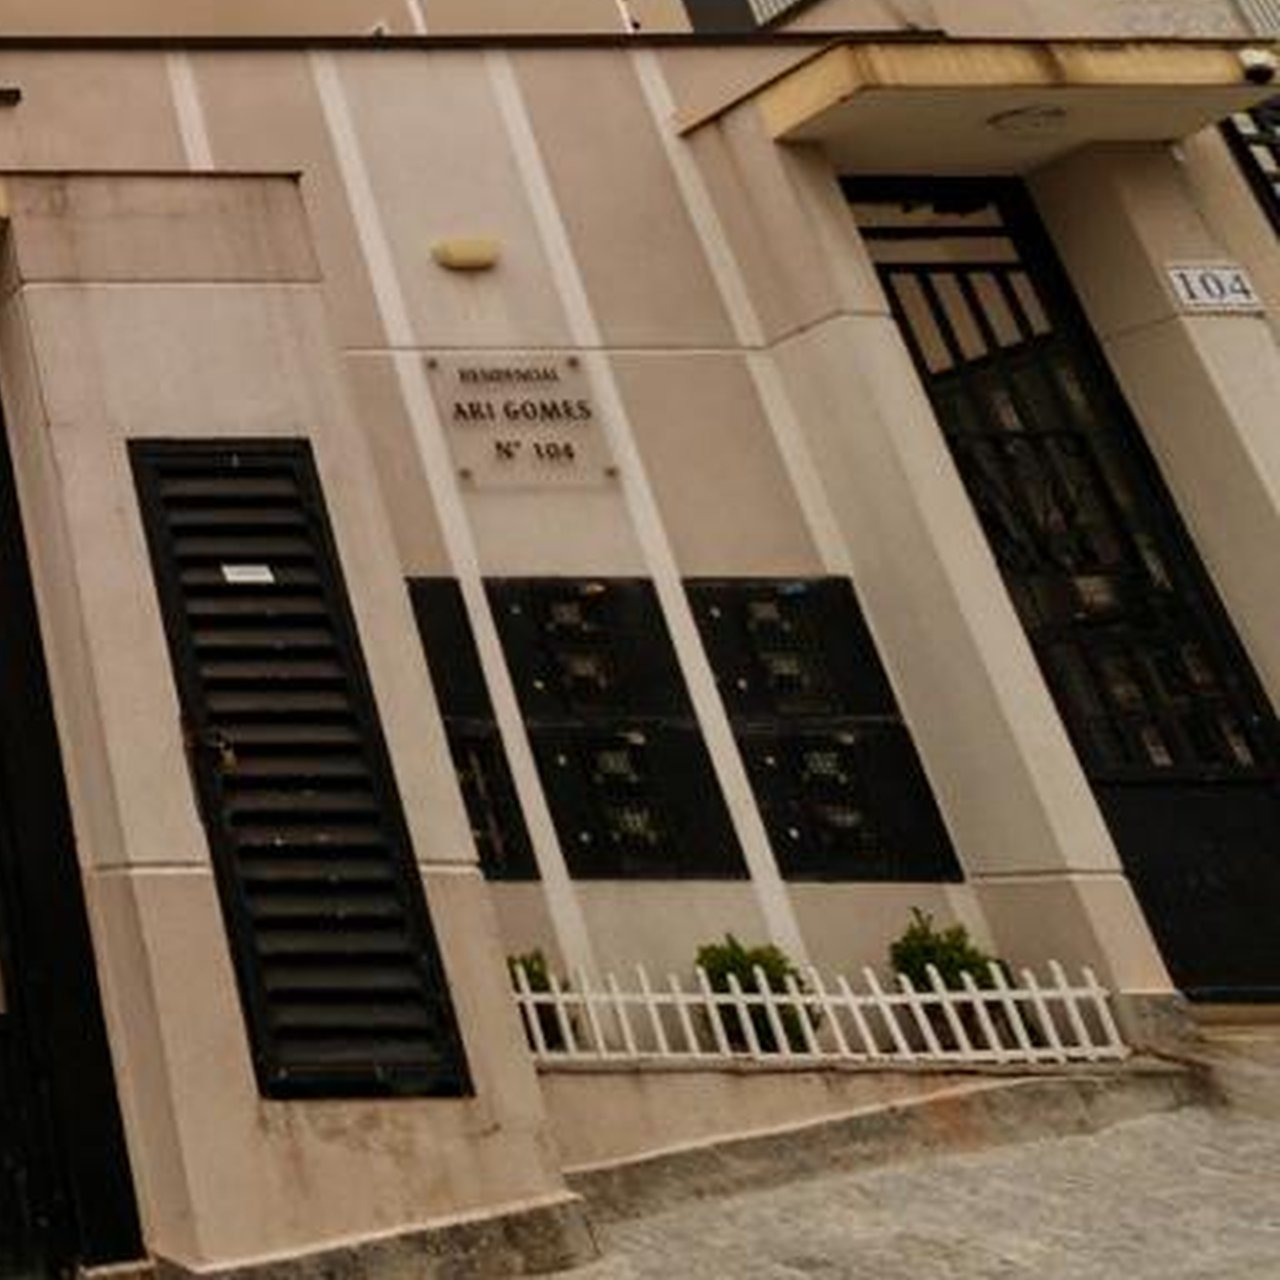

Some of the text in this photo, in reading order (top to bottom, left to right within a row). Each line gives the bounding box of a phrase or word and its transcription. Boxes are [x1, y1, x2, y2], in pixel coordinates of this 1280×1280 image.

[1175, 272, 1252, 300] 104
[453, 400, 592, 421] ARI GOMES
[533, 442, 575, 460] 104
